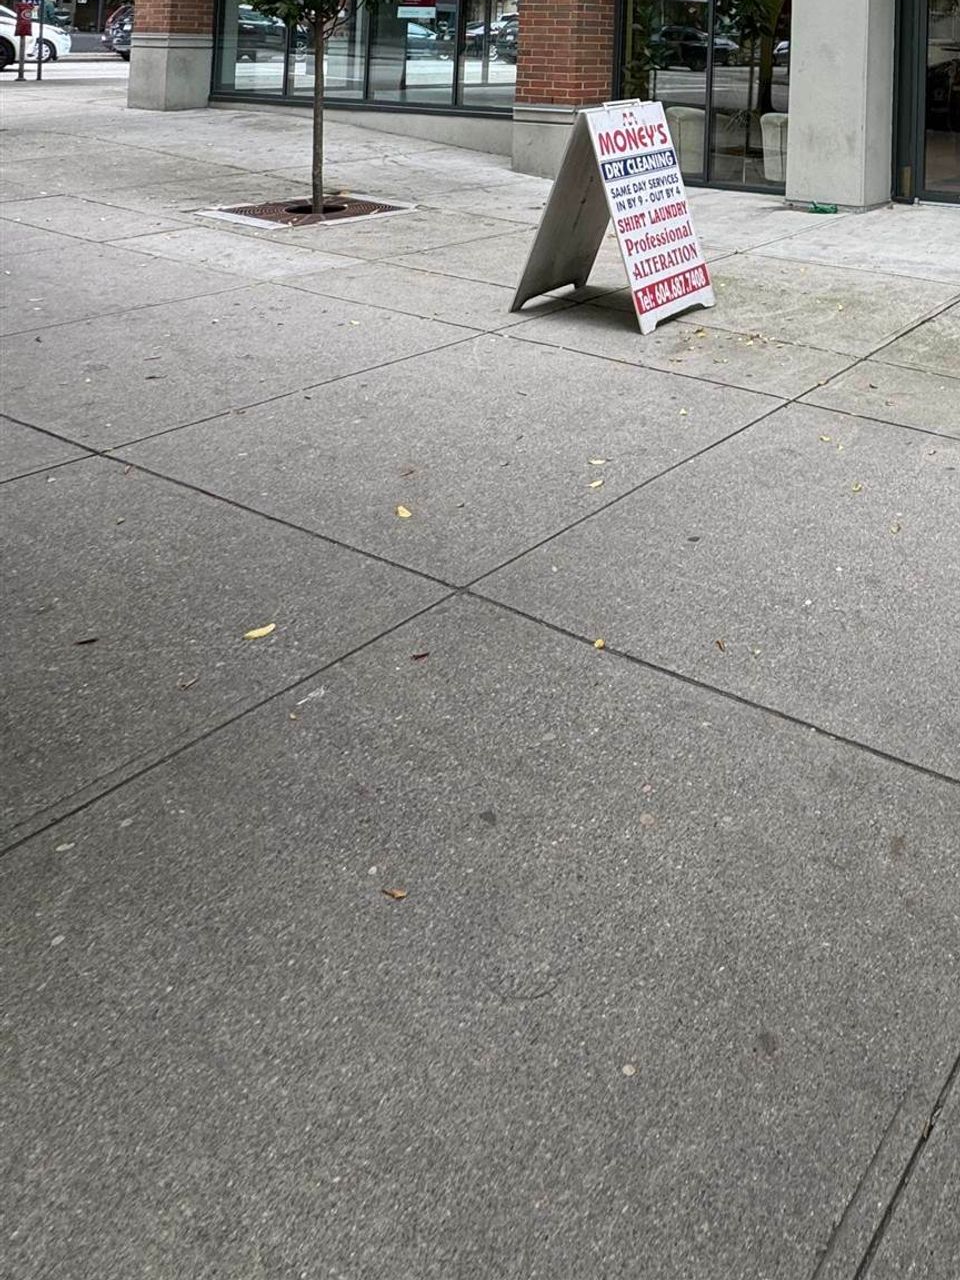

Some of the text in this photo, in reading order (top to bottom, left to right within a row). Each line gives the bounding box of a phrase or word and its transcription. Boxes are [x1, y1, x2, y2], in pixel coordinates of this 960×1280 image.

[598, 123, 668, 156] MONEY'S
[604, 152, 674, 179] DRY CLEANING
[610, 173, 679, 199] SAME DAY SERVICES
[616, 201, 626, 213] IN
[627, 198, 637, 210] BY
[638, 196, 643, 206] 9
[649, 190, 665, 204] OUT
[664, 187, 674, 199] BY
[675, 186, 681, 196] 4
[617, 201, 688, 234] SHIRT LAUNDRY
[625, 221, 693, 257] Professional
[633, 242, 698, 280] ALTERATION
[636, 288, 655, 312] Tel:
